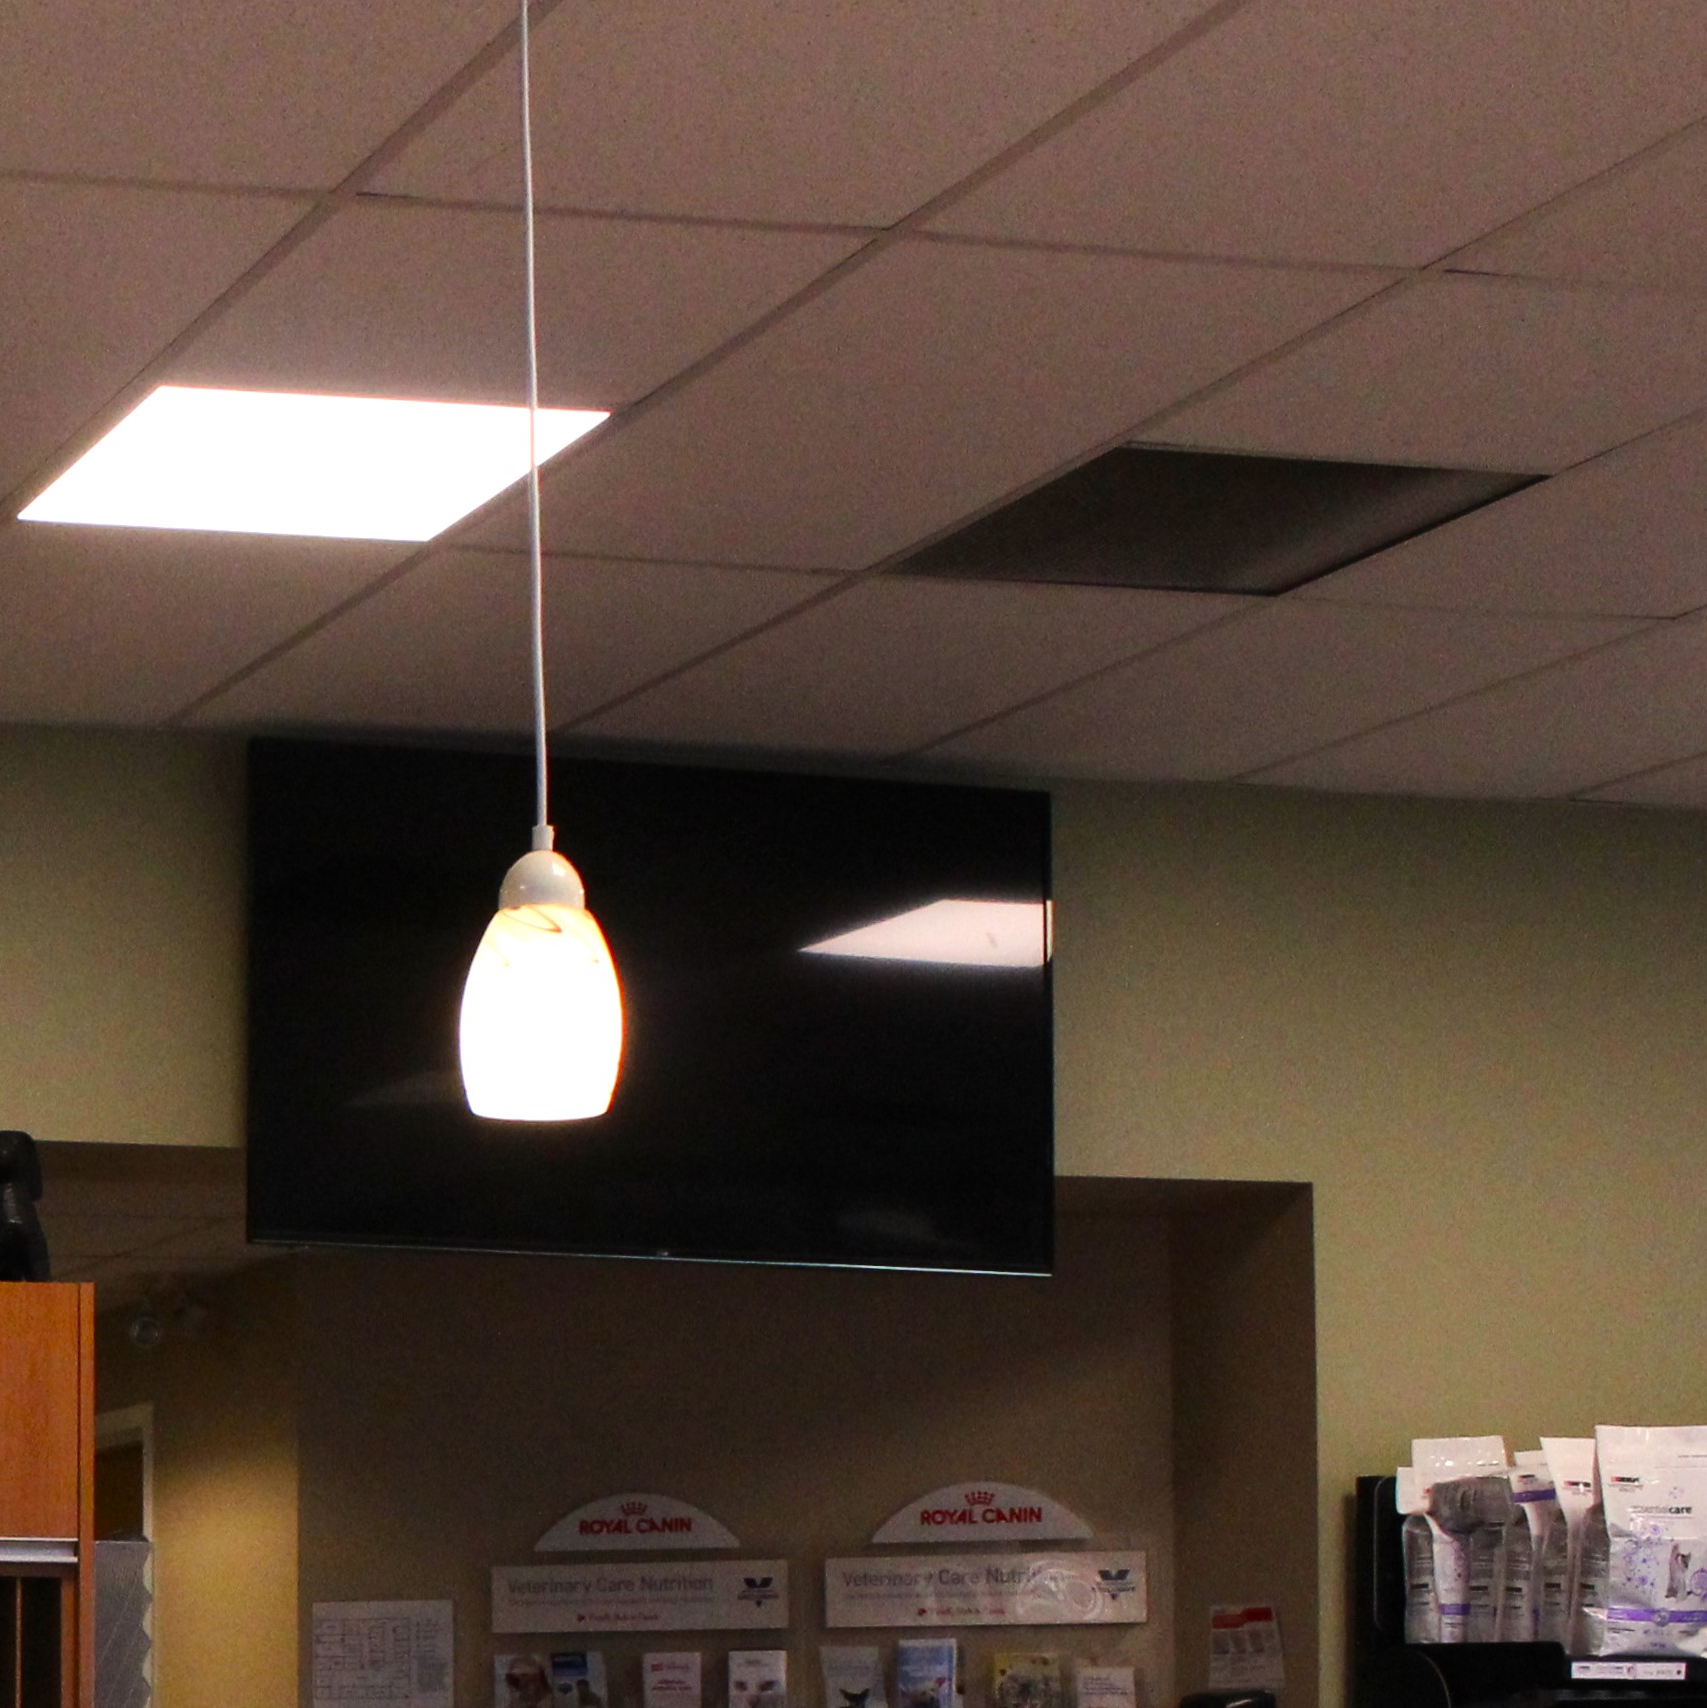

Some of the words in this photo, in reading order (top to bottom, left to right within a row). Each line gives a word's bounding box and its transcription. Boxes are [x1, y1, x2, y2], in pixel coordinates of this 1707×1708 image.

[921, 1508, 976, 1526] ROYAL
[982, 1506, 1042, 1524] CANIN
[579, 1519, 632, 1536] ROYAL
[637, 1517, 692, 1534] CANIN
[507, 1579, 592, 1597] Veterinary
[596, 1578, 635, 1593] Care
[640, 1576, 714, 1593] Nutrition
[938, 1569, 981, 1586] Care
